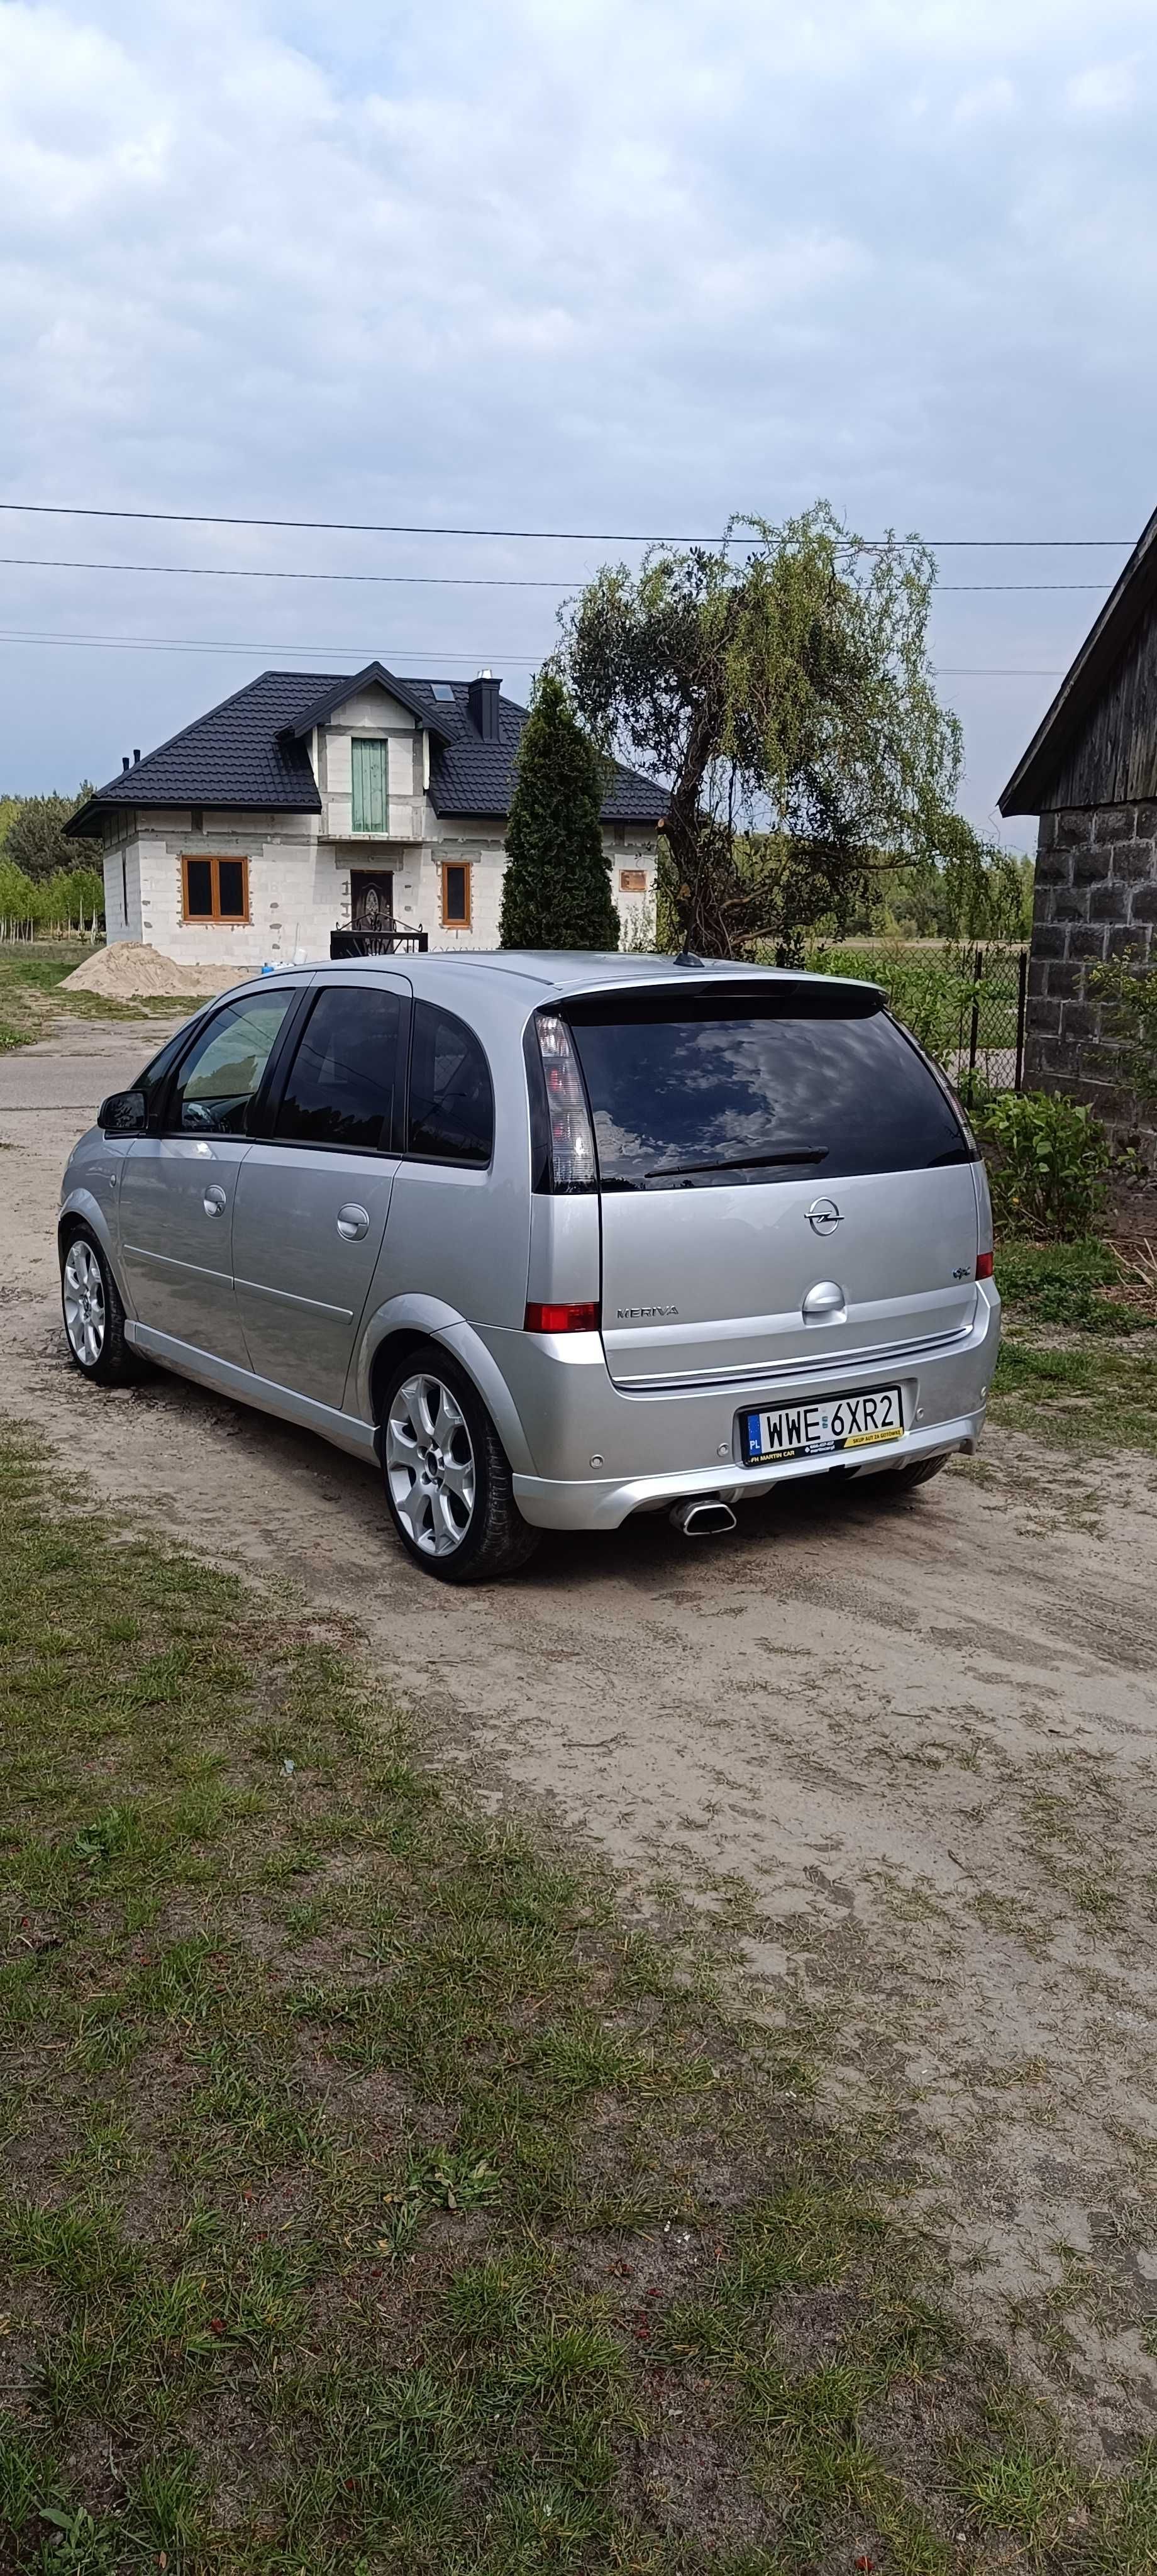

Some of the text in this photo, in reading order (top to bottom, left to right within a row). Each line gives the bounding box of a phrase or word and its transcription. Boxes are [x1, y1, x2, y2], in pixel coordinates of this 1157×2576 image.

[617, 1306, 679, 1318] MERIVA
[767, 1395, 894, 1448] WWE 6XR2
[750, 1440, 760, 1450] PL
[760, 1452, 782, 1461] MARTIN
